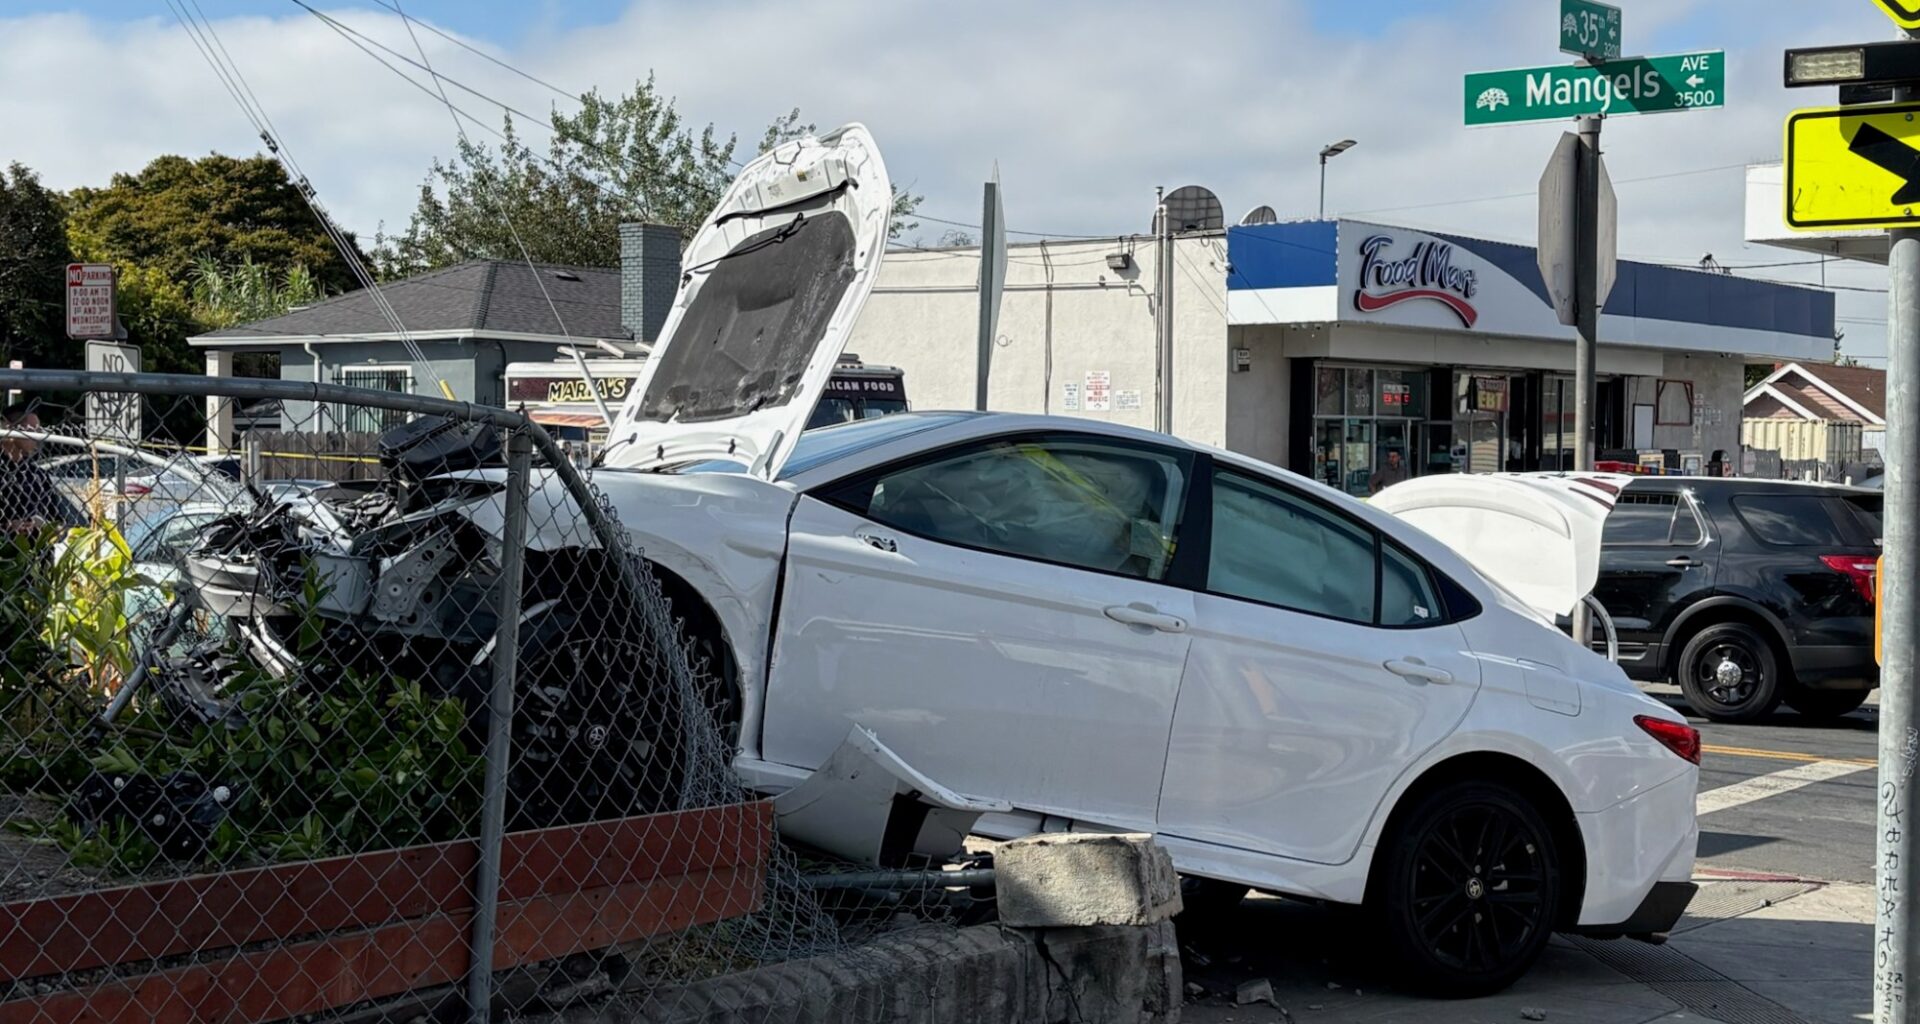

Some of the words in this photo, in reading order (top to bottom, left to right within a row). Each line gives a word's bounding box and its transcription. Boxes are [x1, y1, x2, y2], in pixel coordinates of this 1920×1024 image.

[1579, 10, 1605, 48] 35th
[1607, 9, 1618, 25] AVE
[1525, 65, 1660, 112] Mangels
[1680, 55, 1709, 72] AVE
[1674, 90, 1714, 107] 3500
[1360, 235, 1426, 288] Food
[1424, 241, 1477, 297] Mart
[69, 269, 82, 282] NO
[82, 271, 111, 280] PARKING
[90, 288, 99, 296] AM
[101, 288, 108, 296] TO
[91, 298, 109, 306] NOON
[863, 382, 894, 391] FOOD
[1478, 391, 1504, 409] EBT
[1894, 972, 1903, 1003] RIP
